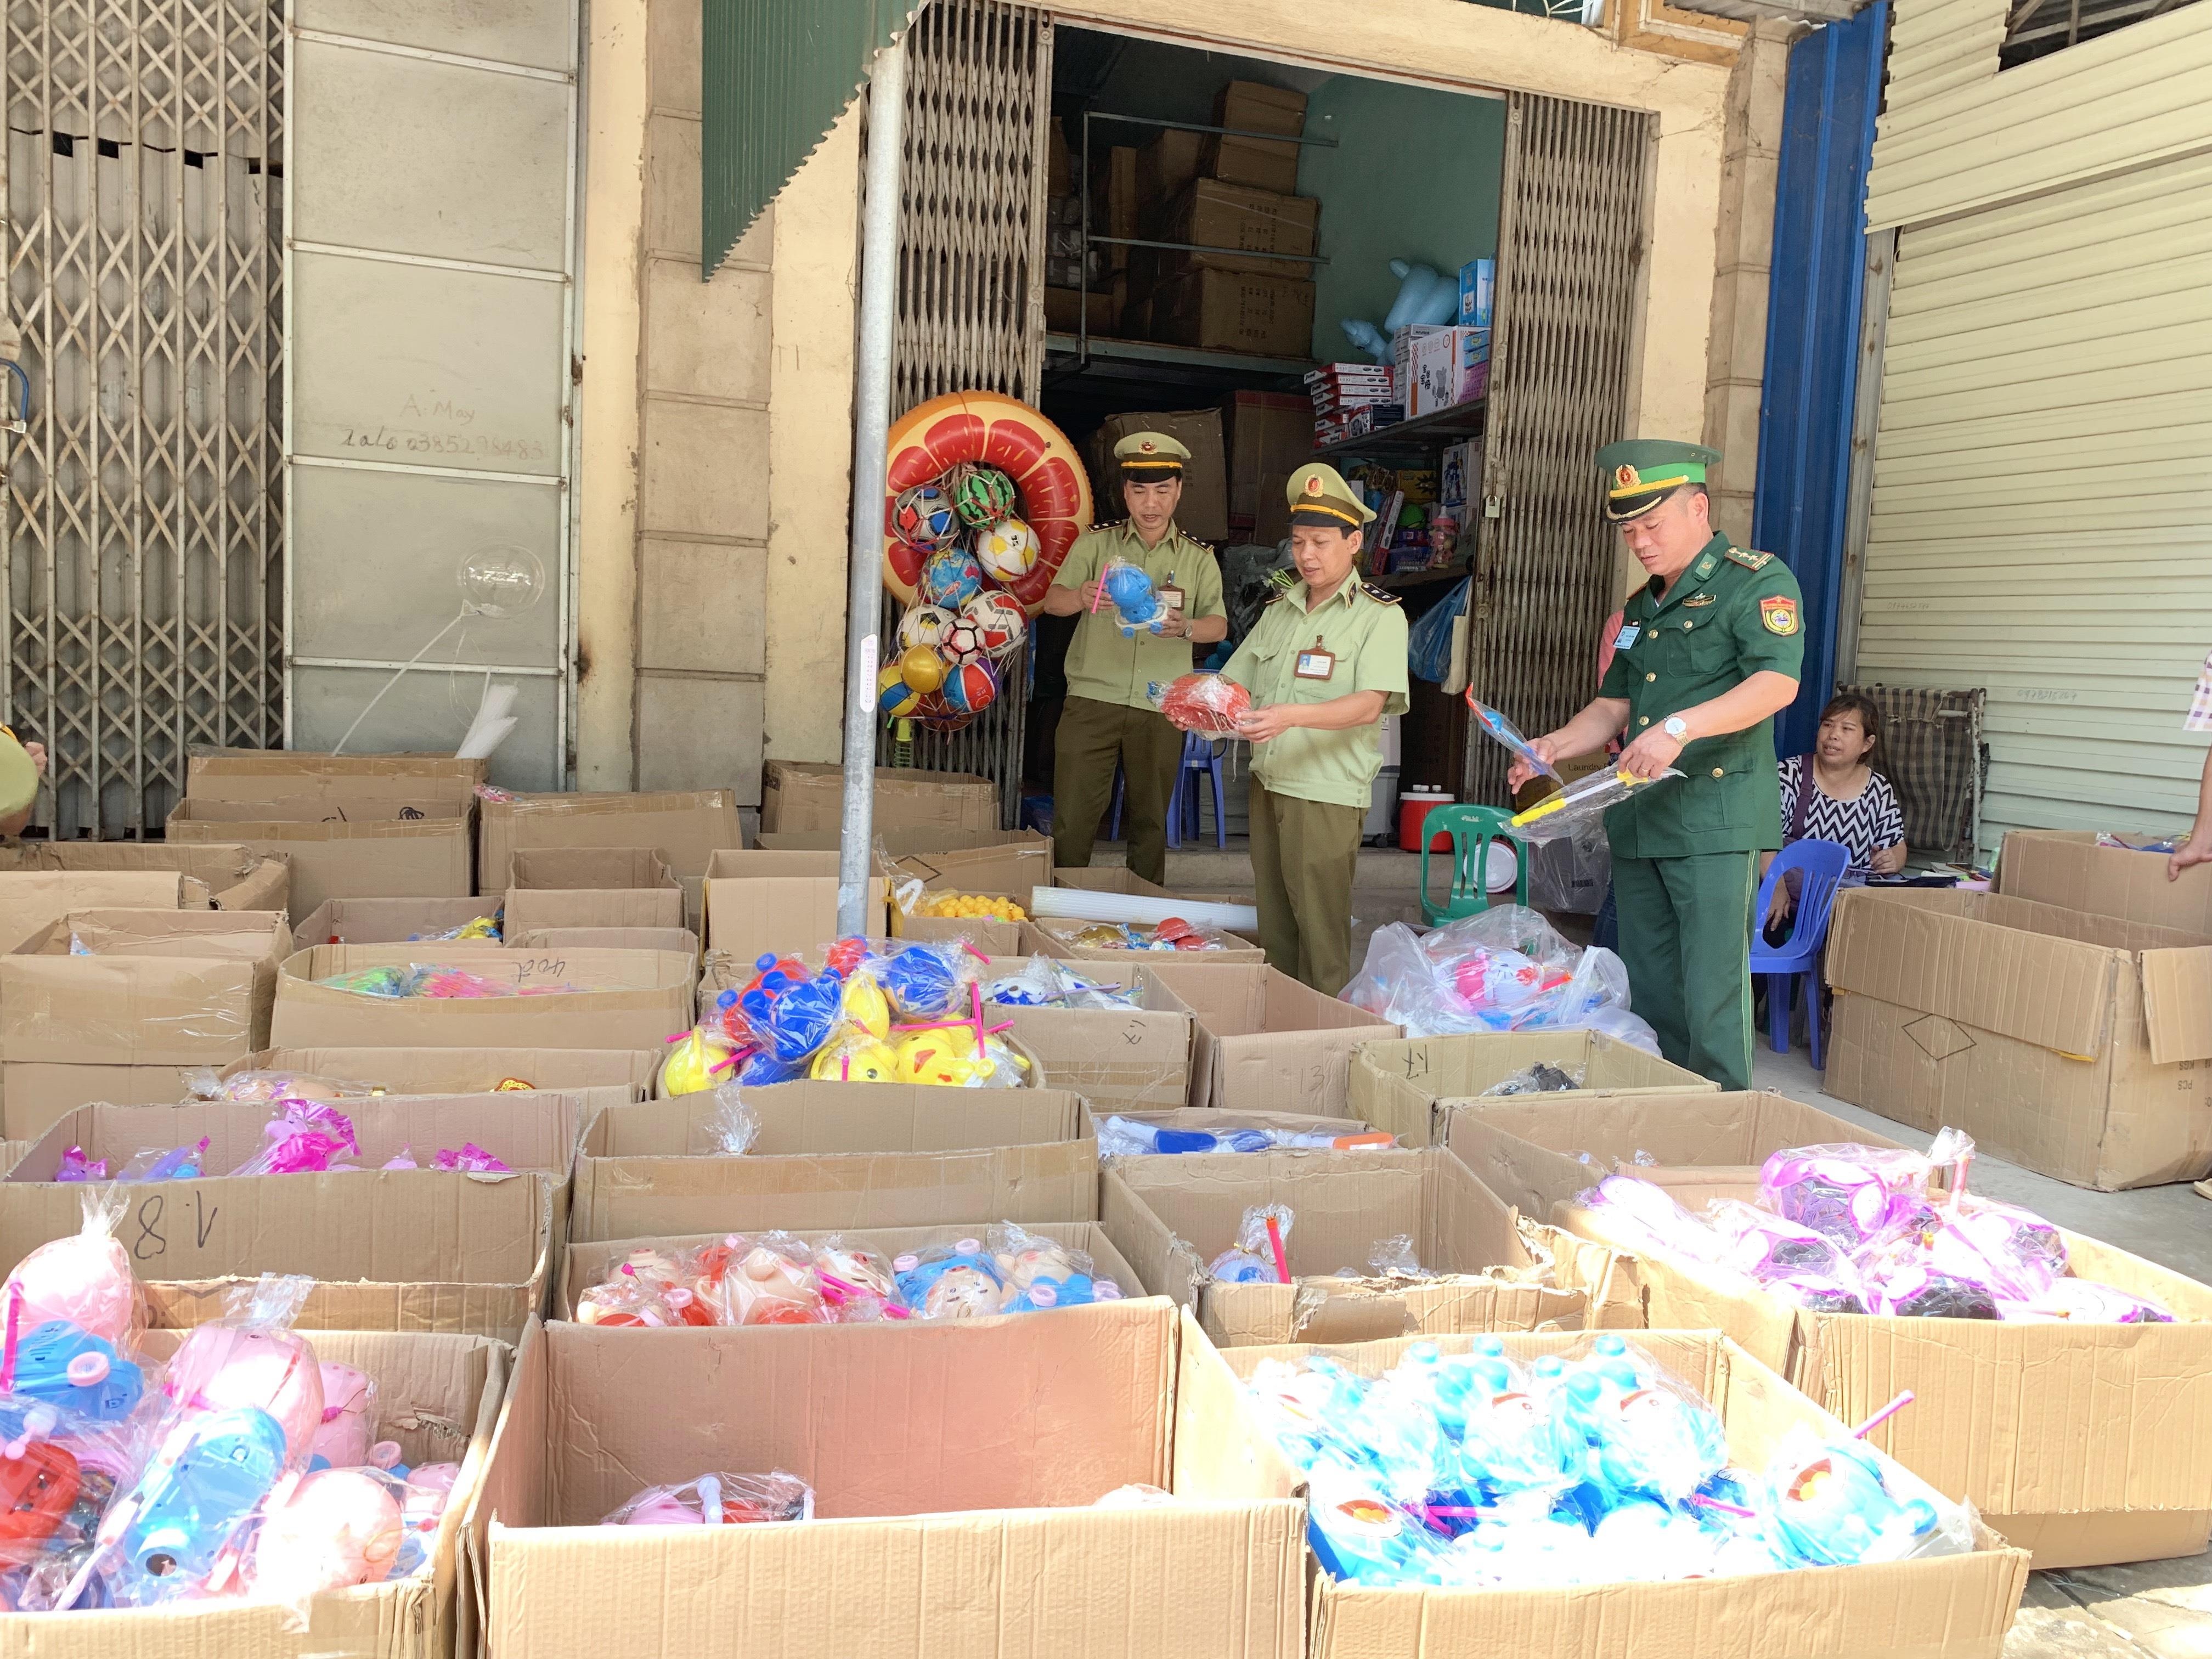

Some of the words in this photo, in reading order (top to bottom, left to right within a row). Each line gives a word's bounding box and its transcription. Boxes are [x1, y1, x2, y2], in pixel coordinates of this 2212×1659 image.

[2179, 1060, 2194, 1070] KGS
[1300, 1065, 1325, 1094] 13
[2177, 1079, 2193, 1090] PCS
